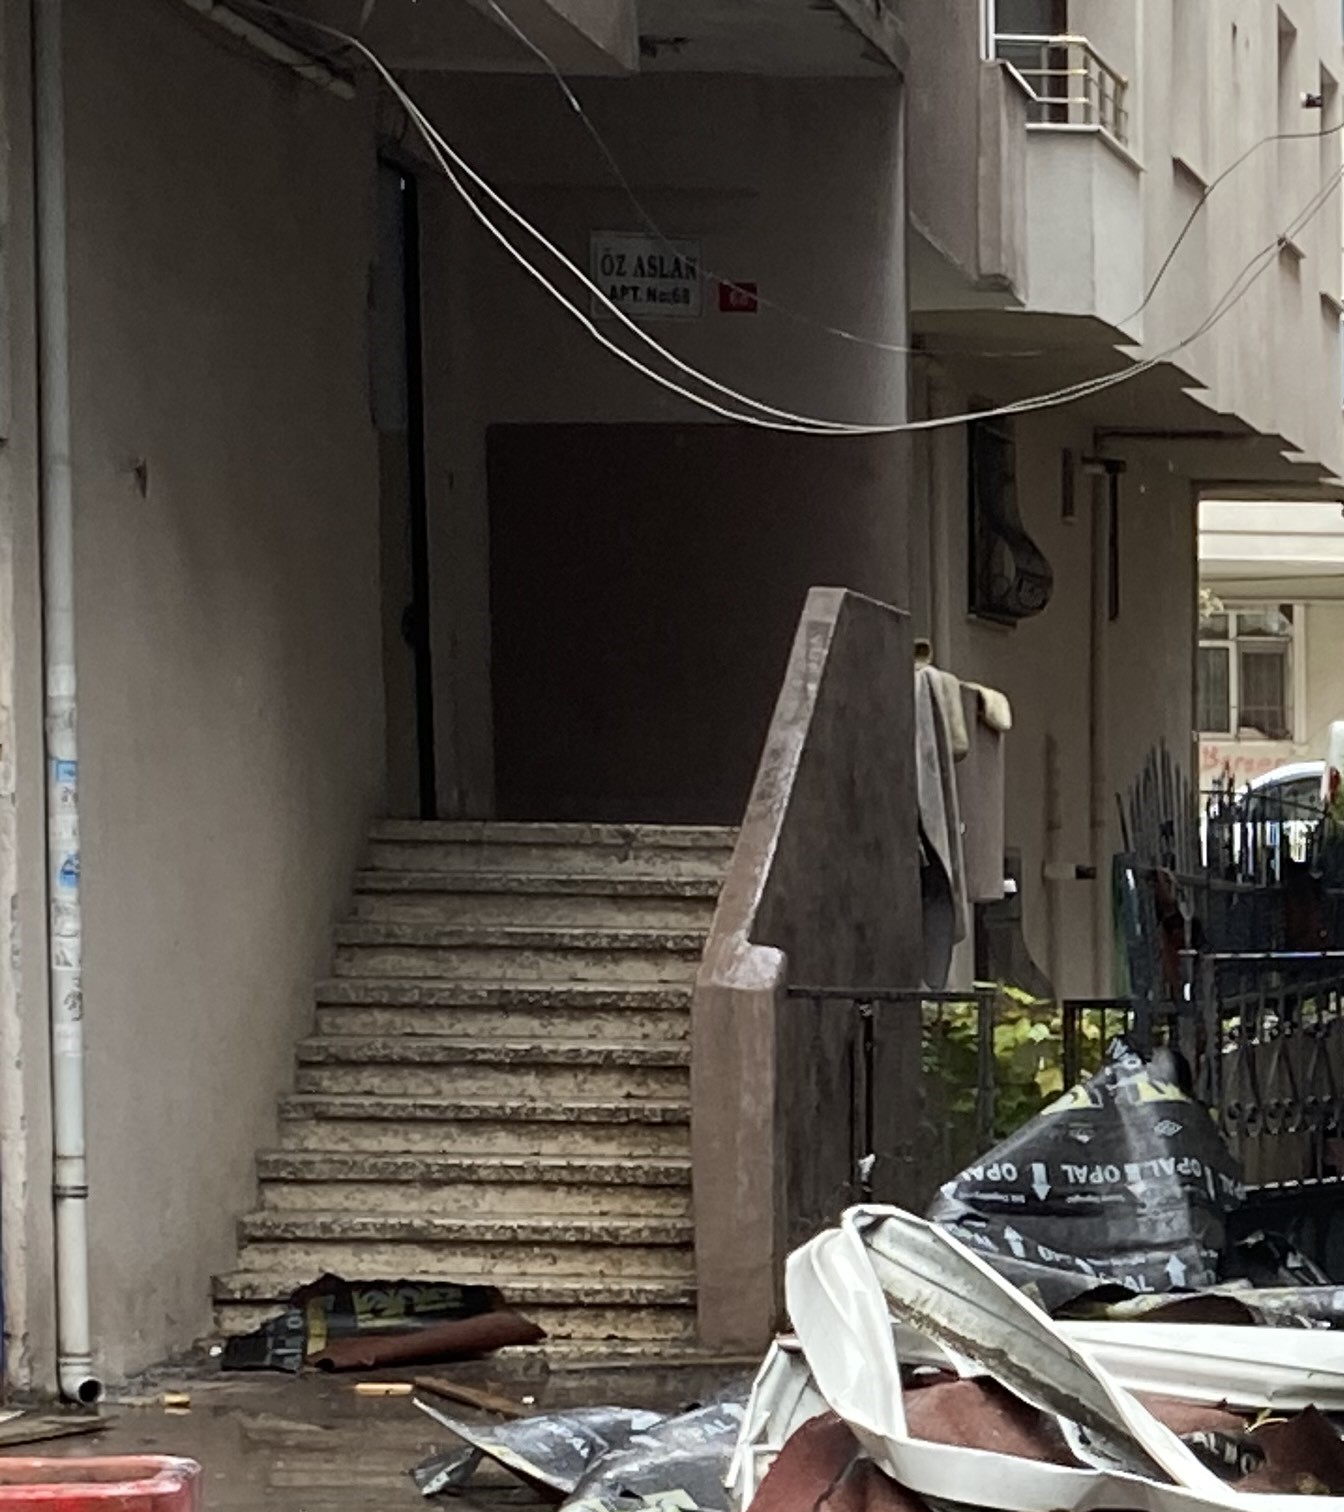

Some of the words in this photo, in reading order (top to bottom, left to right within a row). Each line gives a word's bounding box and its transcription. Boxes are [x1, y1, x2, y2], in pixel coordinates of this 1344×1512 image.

[600, 247, 627, 277] ÖZ
[632, 254, 698, 281] ASLAN
[1060, 1163, 1122, 1184] OPAL
